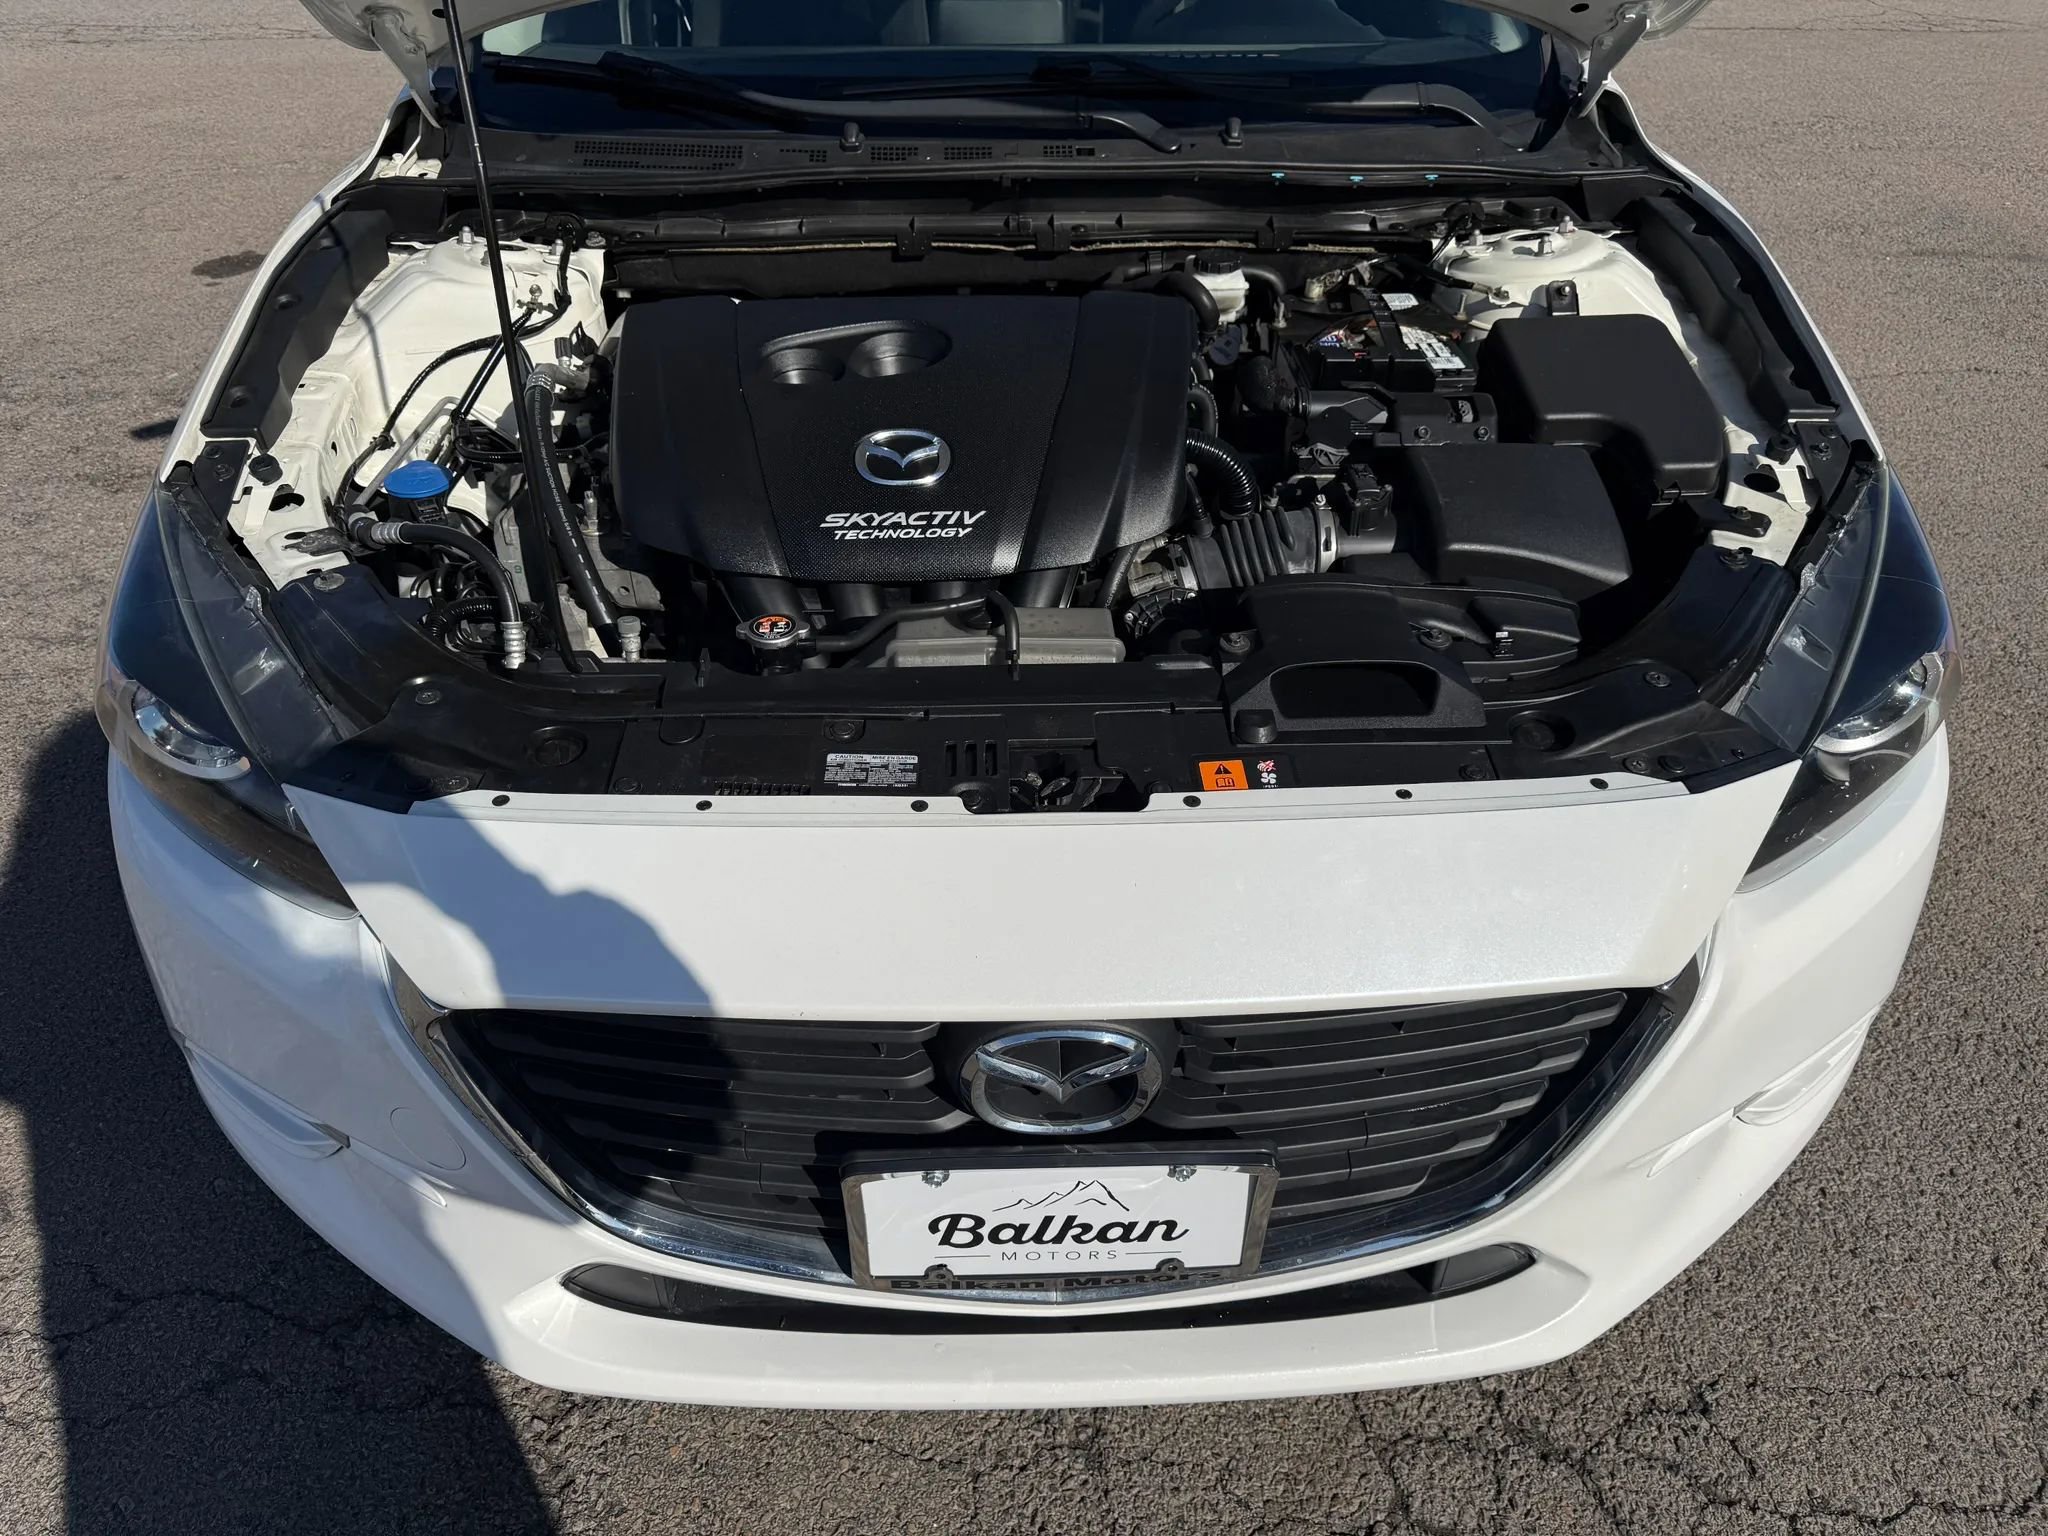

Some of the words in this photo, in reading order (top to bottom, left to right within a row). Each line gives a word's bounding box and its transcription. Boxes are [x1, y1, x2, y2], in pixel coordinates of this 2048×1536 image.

[545, 467, 556, 489] SUCTION
[552, 488, 561, 503] HOSE
[819, 510, 987, 528] SKYACTIV
[833, 527, 973, 540] TECHNOLOGY
[928, 1213, 1190, 1249] Balkan
[1001, 1250, 1118, 1261] MOTORS
[890, 1279, 1045, 1290] Balkan
[1063, 1271, 1222, 1288] Motors
